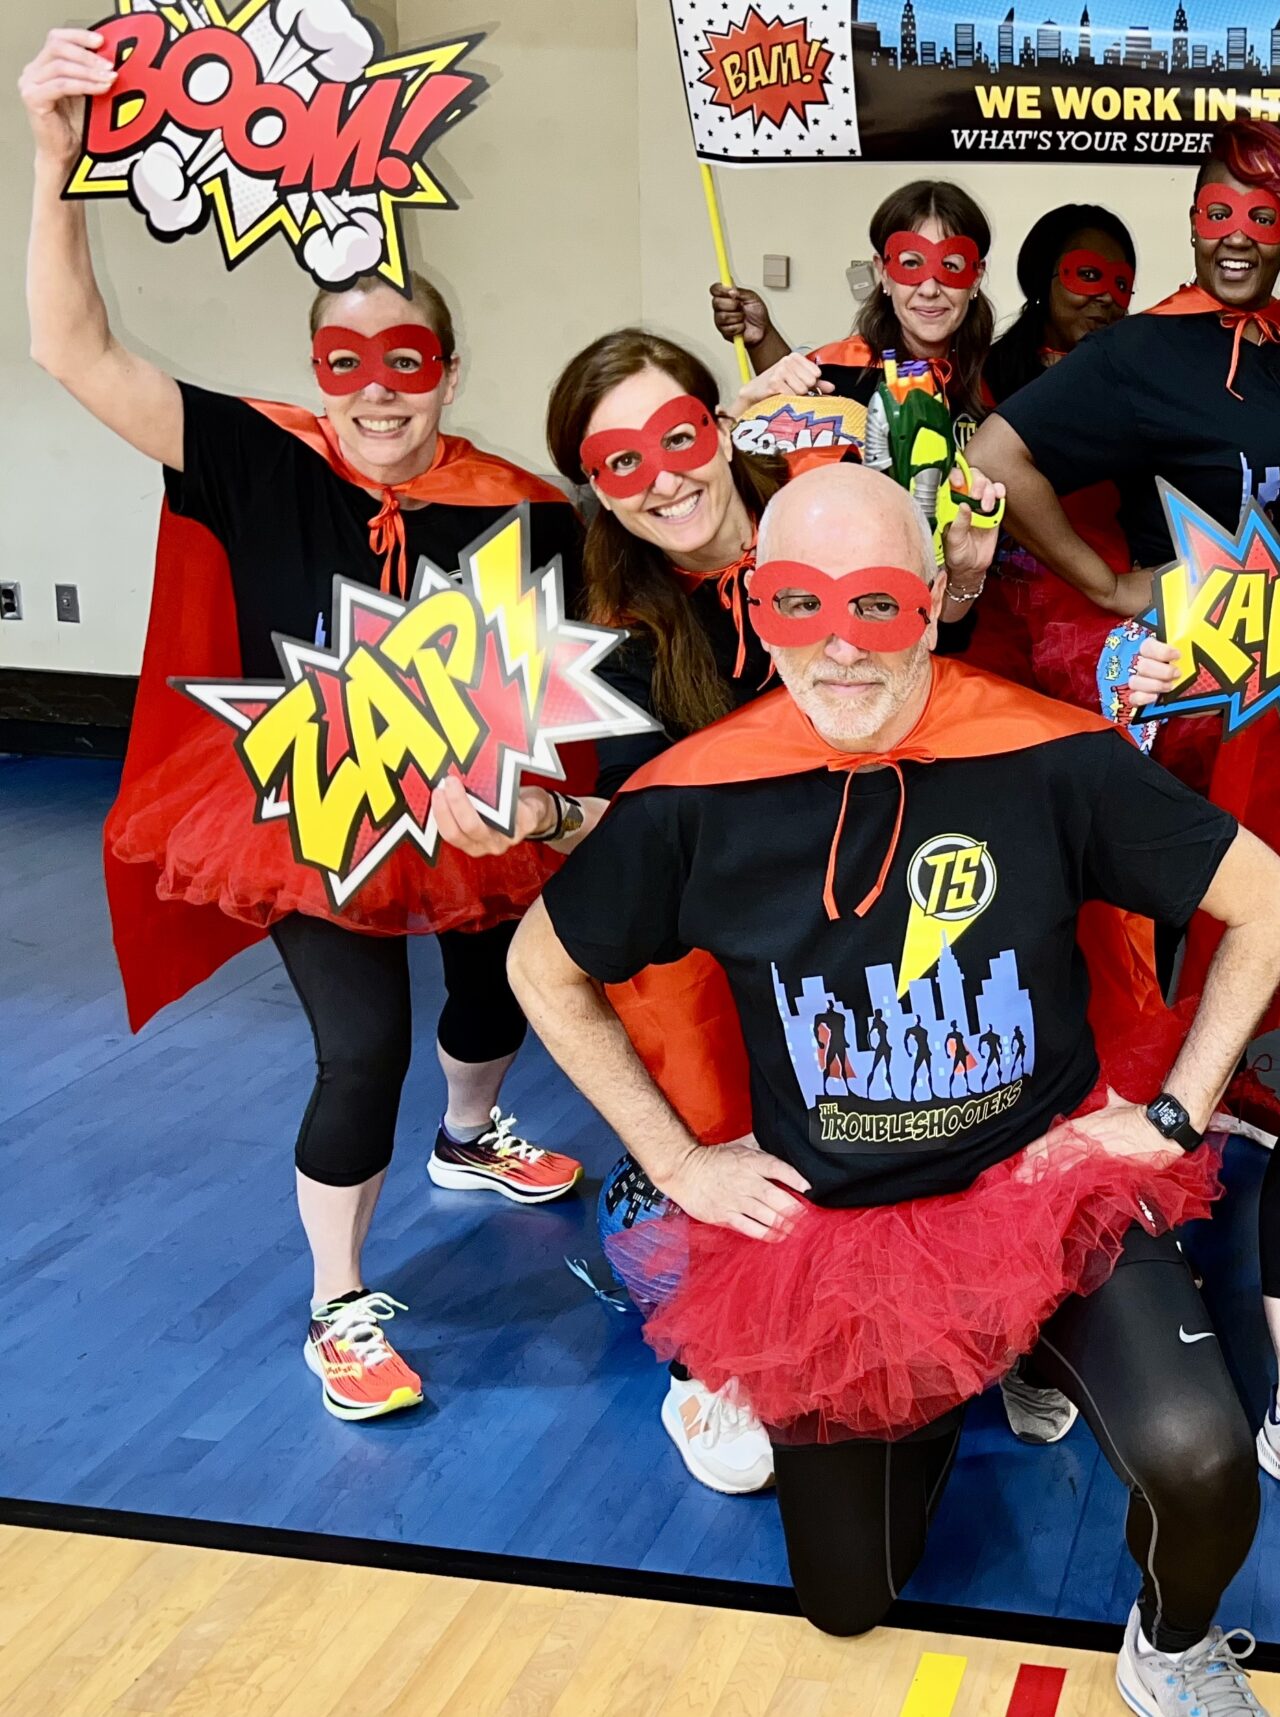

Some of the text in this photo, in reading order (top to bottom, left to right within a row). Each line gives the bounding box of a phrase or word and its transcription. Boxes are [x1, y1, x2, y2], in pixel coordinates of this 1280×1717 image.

[719, 38, 823, 100] BAM!
[87, 13, 473, 191] BOOM!
[974, 85, 1042, 119] WE
[1051, 86, 1182, 122] WORK
[1193, 87, 1237, 121] IN
[951, 129, 1052, 150] WHAT'S
[1056, 131, 1128, 152] YOUR
[243, 590, 480, 872] ZAP
[922, 843, 987, 916] TS
[820, 1103, 838, 1116] THE
[821, 1080, 1022, 1142] TROUBLESHOOTERS
